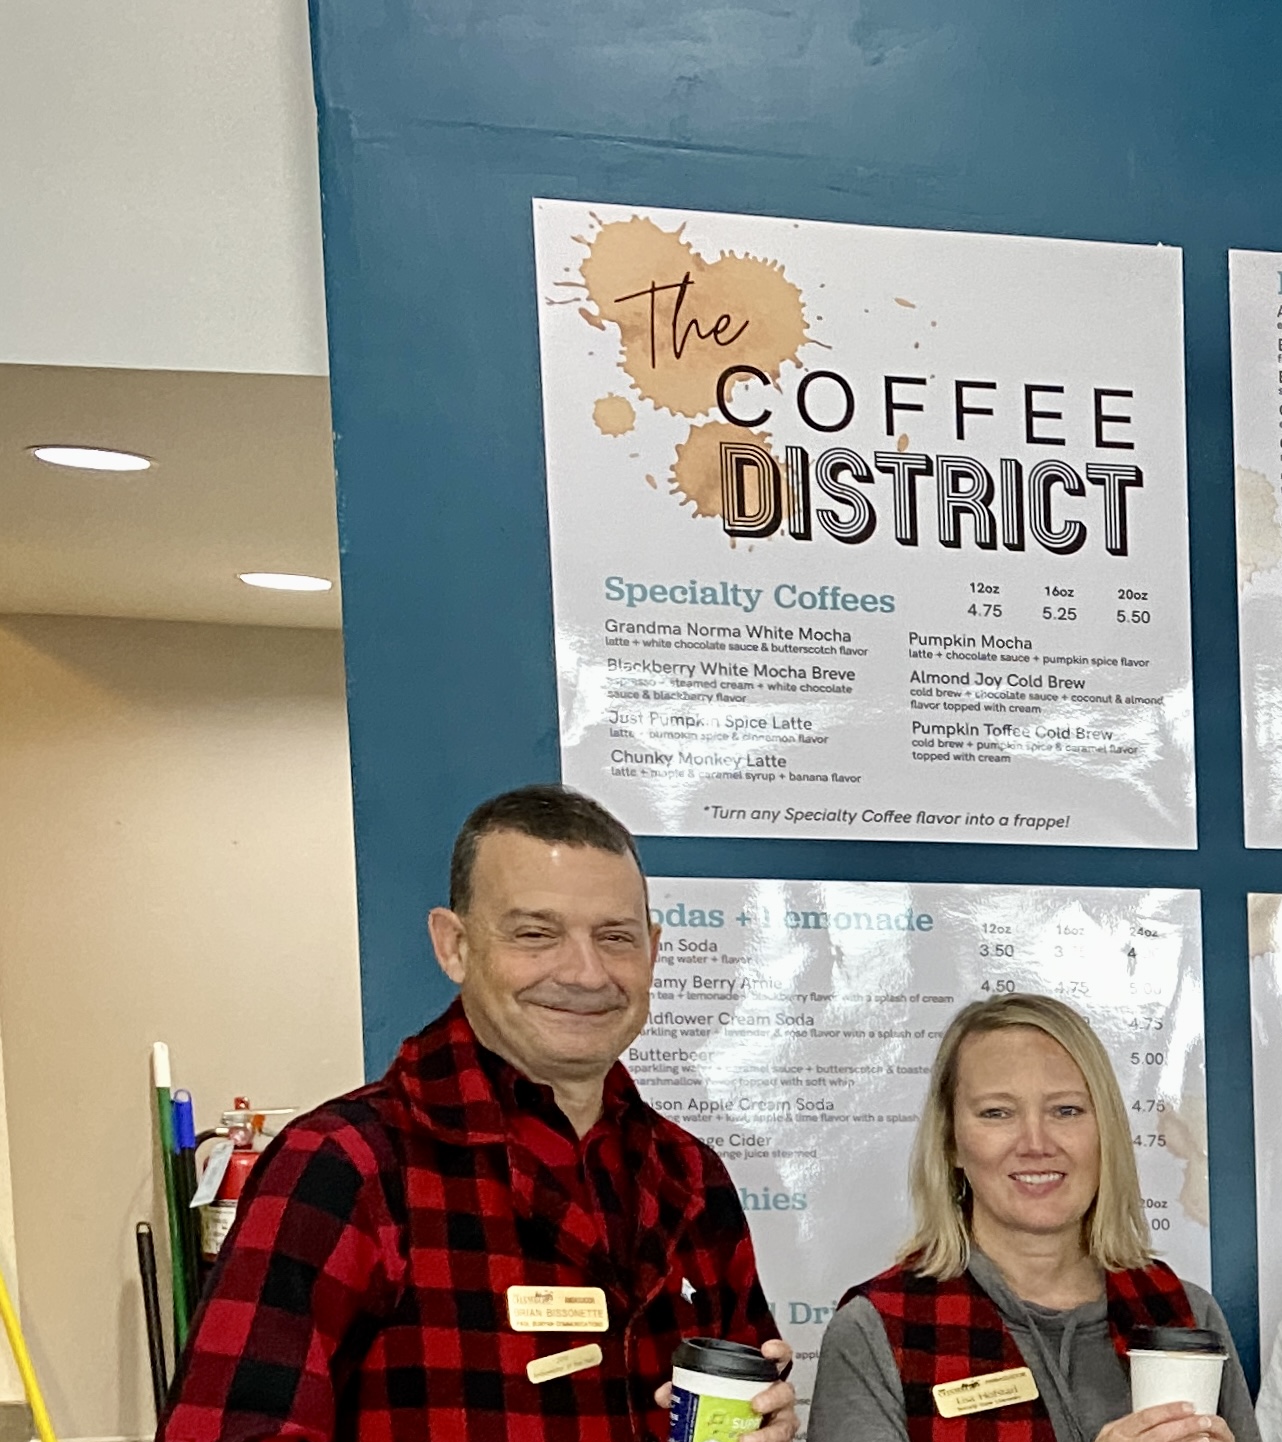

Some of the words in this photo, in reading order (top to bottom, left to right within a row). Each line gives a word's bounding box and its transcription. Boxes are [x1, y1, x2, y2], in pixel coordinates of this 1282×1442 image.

[614, 271, 750, 369] The
[716, 364, 1136, 450] COFFEE
[719, 441, 1143, 557] DISTRICT
[605, 576, 764, 613] Specialty
[774, 584, 895, 613] Coffees
[970, 582, 1000, 594] 12oz
[1045, 586, 1074, 598] 16oz
[1117, 588, 1148, 601] 20oz
[967, 603, 1002, 618] 4.75
[1043, 606, 1077, 621] 5.25
[1117, 610, 1151, 624] 5.50
[605, 618, 682, 636] Grandma
[687, 622, 741, 638] Norma
[745, 624, 794, 640] White
[799, 627, 851, 642] Mocha
[605, 636, 630, 647] latte
[631, 640, 640, 648] +
[642, 638, 672, 649] white
[674, 639, 726, 651] chocolate
[728, 643, 759, 652] sauce
[771, 643, 837, 655] butterscotch
[839, 646, 868, 656] flavor
[909, 632, 976, 650] Pumpkin
[981, 634, 1032, 650] Mocha
[607, 658, 696, 678] Blackberry
[700, 661, 749, 677] White
[754, 663, 807, 679] Mocha
[812, 666, 856, 681] Breve
[910, 670, 970, 685] Almond
[974, 672, 1003, 687] Joy
[1007, 673, 1043, 688] Cold
[1048, 675, 1086, 689] Brew
[910, 699, 941, 710] flavor
[943, 701, 981, 713] topped
[983, 703, 1006, 712] with
[1008, 705, 1042, 713] cream
[611, 749, 673, 767] Chunky
[678, 751, 744, 768] Monkey
[747, 754, 787, 768] Latte
[750, 810, 781, 824] any
[784, 807, 858, 825] Specialty
[861, 809, 912, 824] Coffee
[916, 810, 962, 825] flavor
[965, 813, 995, 826] into
[999, 816, 1009, 826] a
[1014, 813, 1070, 831] frappe!
[982, 923, 1012, 934] 12oz
[678, 938, 718, 952] Soda
[979, 944, 1014, 958] 3.50
[981, 979, 1015, 992] 4.50
[1130, 1052, 1164, 1065] 5.00
